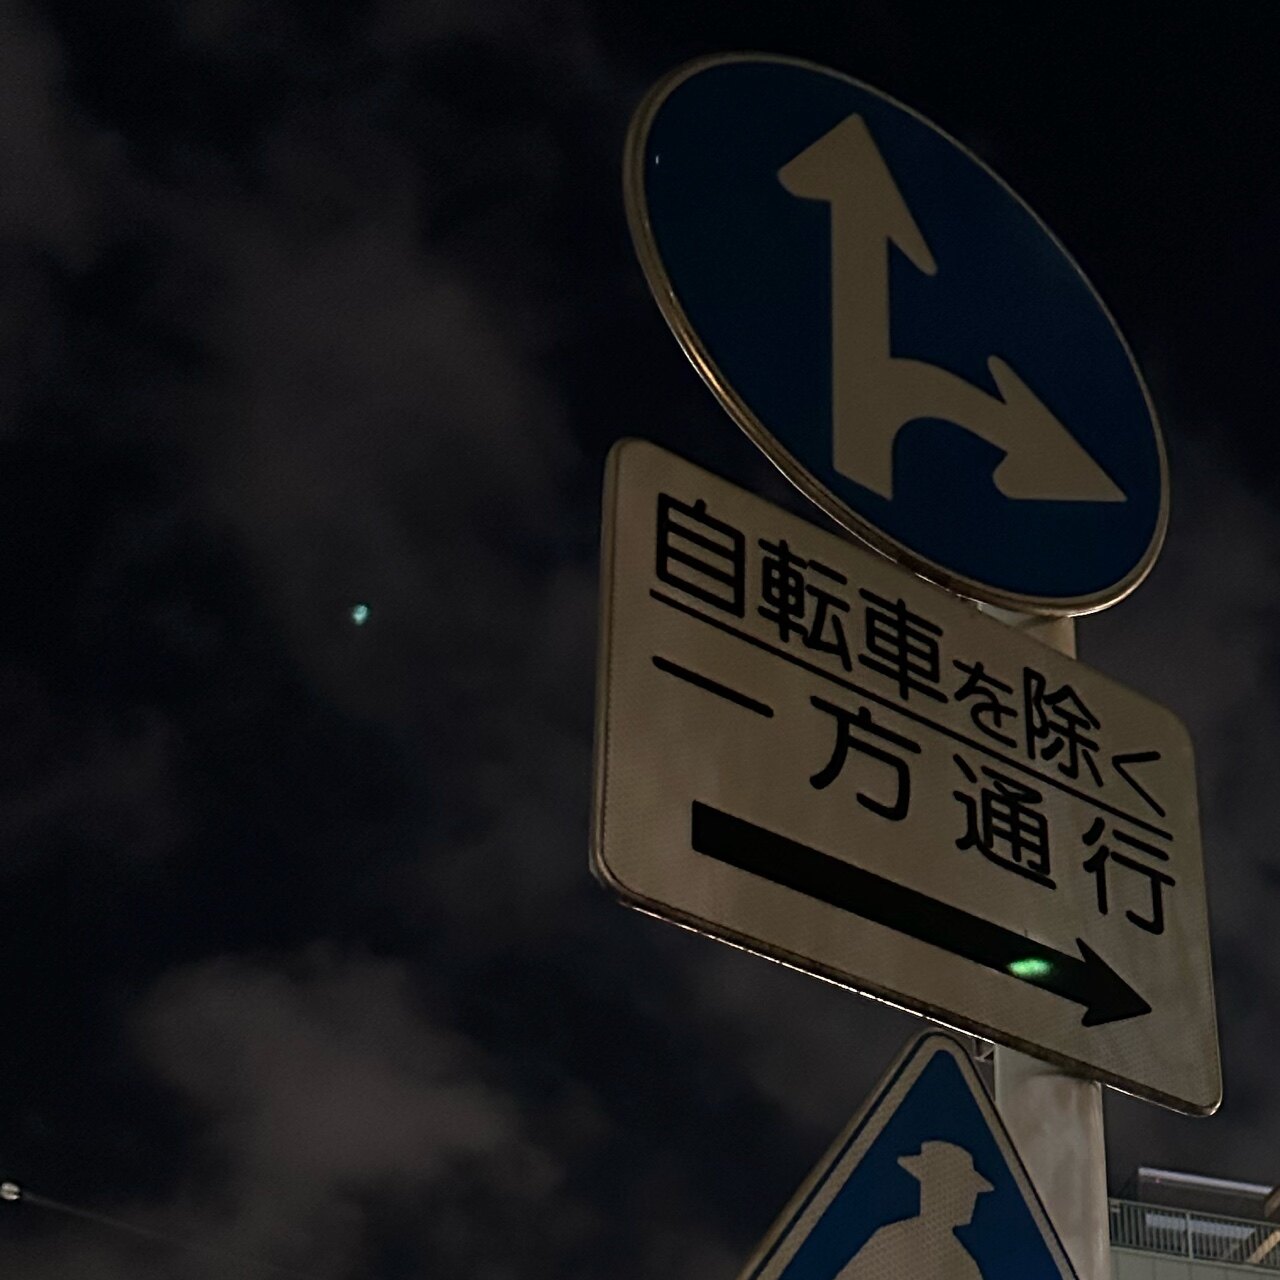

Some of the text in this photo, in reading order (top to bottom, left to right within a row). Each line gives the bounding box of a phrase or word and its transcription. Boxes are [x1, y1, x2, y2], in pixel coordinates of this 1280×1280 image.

[652, 655, 1176, 935] 一方通行
[656, 493, 1162, 817] 自転車を除く
